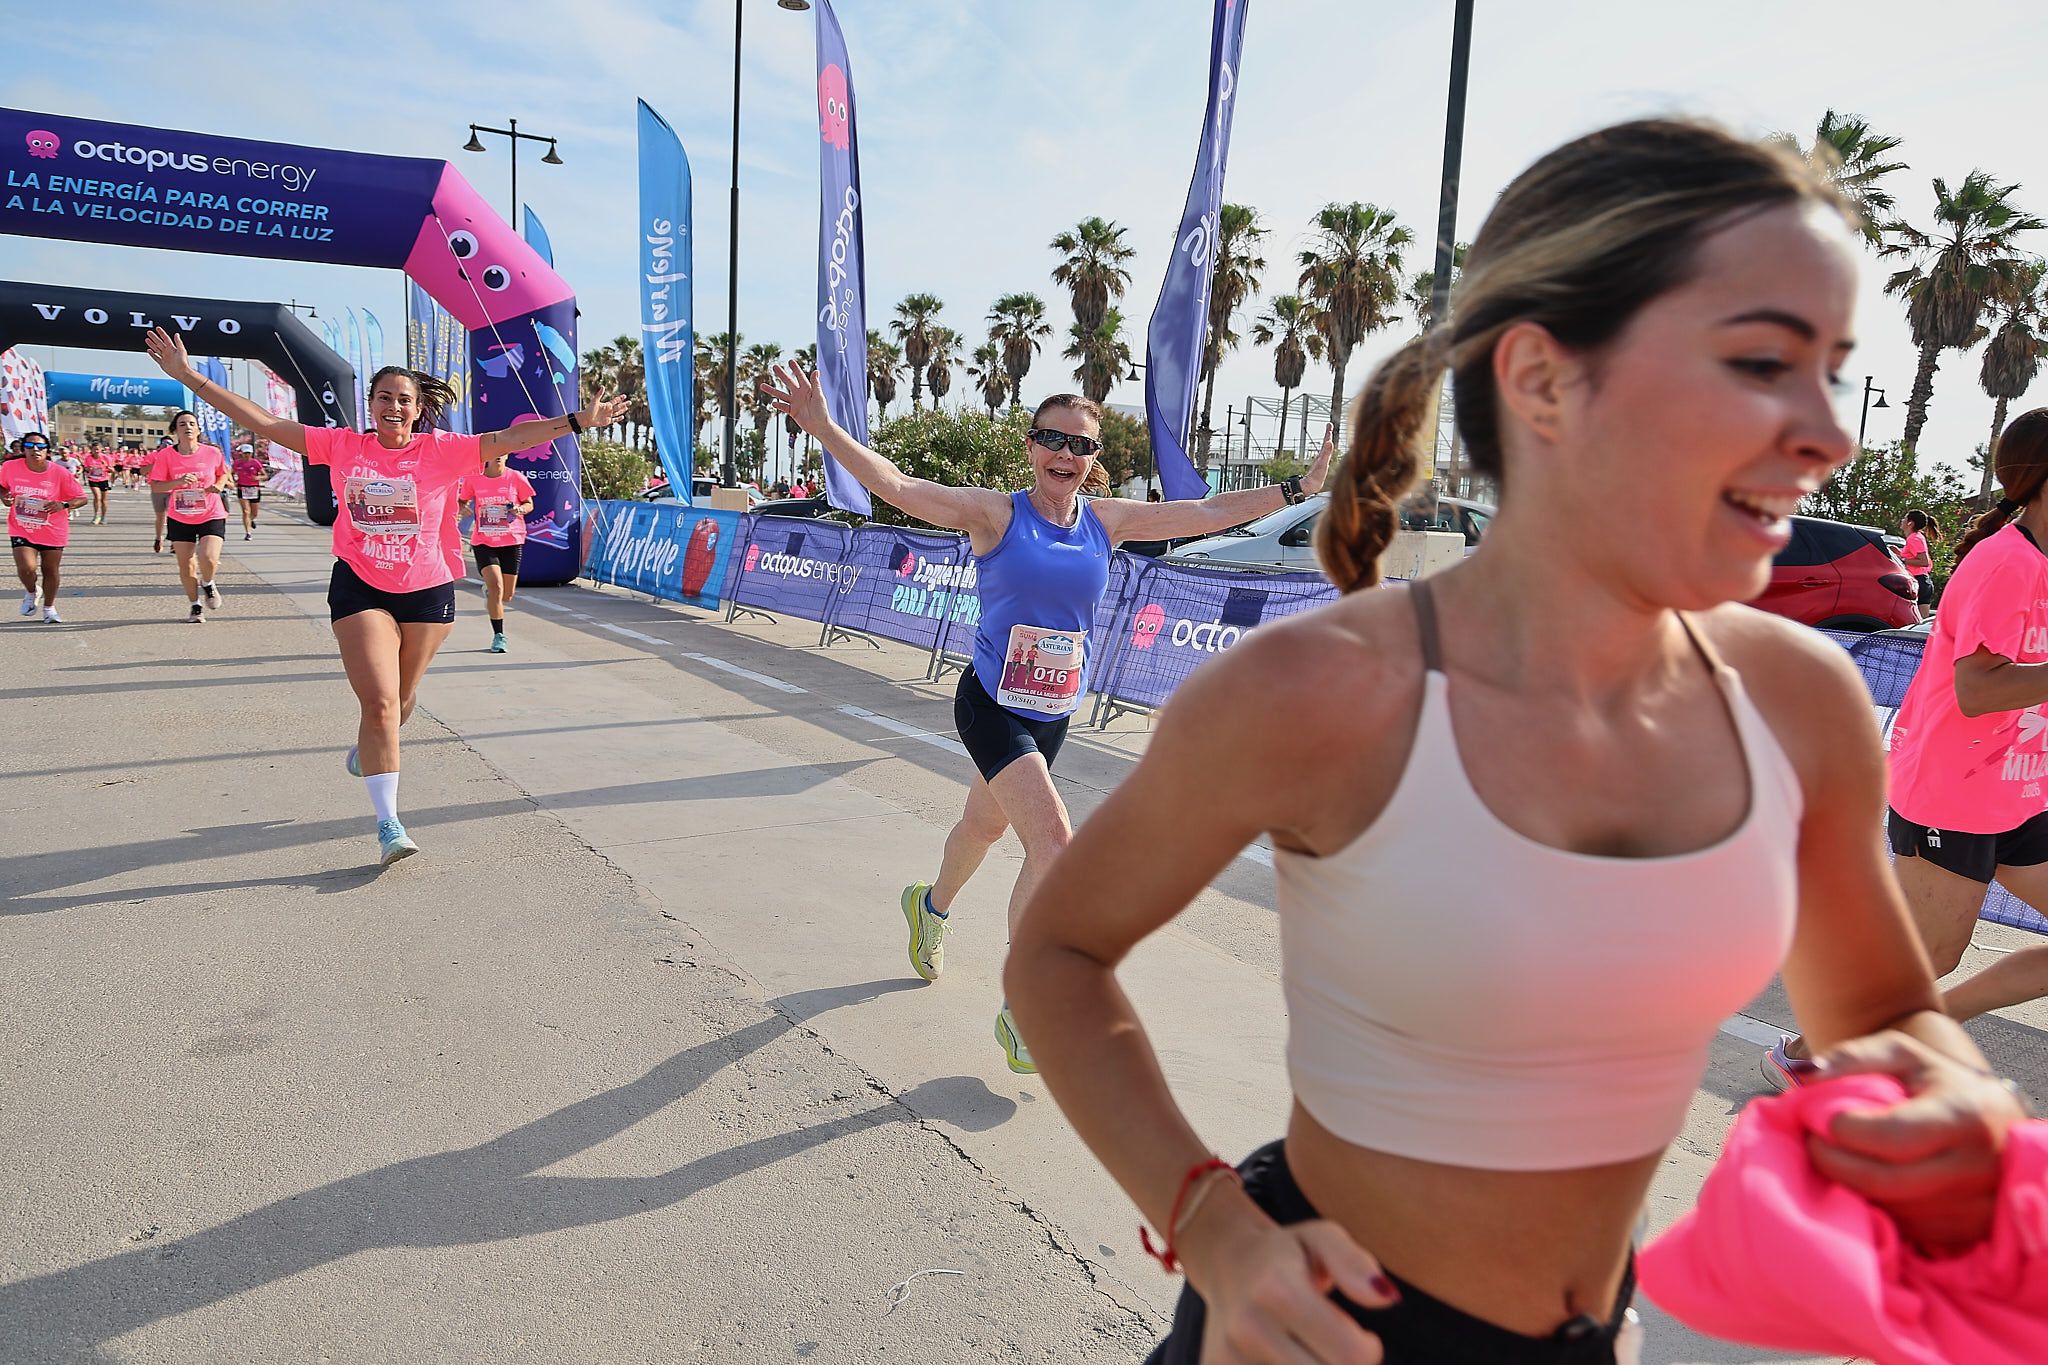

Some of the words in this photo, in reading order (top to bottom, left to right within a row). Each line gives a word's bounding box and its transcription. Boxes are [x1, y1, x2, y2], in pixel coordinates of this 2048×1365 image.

[73, 140, 209, 173] octopus
[212, 157, 316, 193] energy
[7, 169, 41, 190] LA
[47, 175, 158, 203] ENERGÍA
[164, 188, 230, 211] PARA
[236, 197, 330, 221] CORRER
[5, 194, 25, 210] A
[32, 197, 65, 215] LA
[72, 201, 214, 230] VELOCIDAD
[218, 217, 251, 234] DE
[255, 221, 284, 237] LA
[289, 225, 334, 242] LUZ
[31, 303, 242, 335] VOLVO
[90, 377, 150, 400] Marlene
[366, 505, 395, 515] 016
[361, 540, 411, 563] MUJER
[602, 505, 680, 588] Marlene
[375, 560, 394, 571] 2026
[760, 551, 814, 580] octopus
[812, 560, 863, 594] energy
[890, 584, 927, 616] PARA
[927, 590, 952, 620] TU
[1033, 667, 1068, 684] 016
[1041, 684, 1055, 692] 276
[1007, 694, 1036, 706] OYSHO
